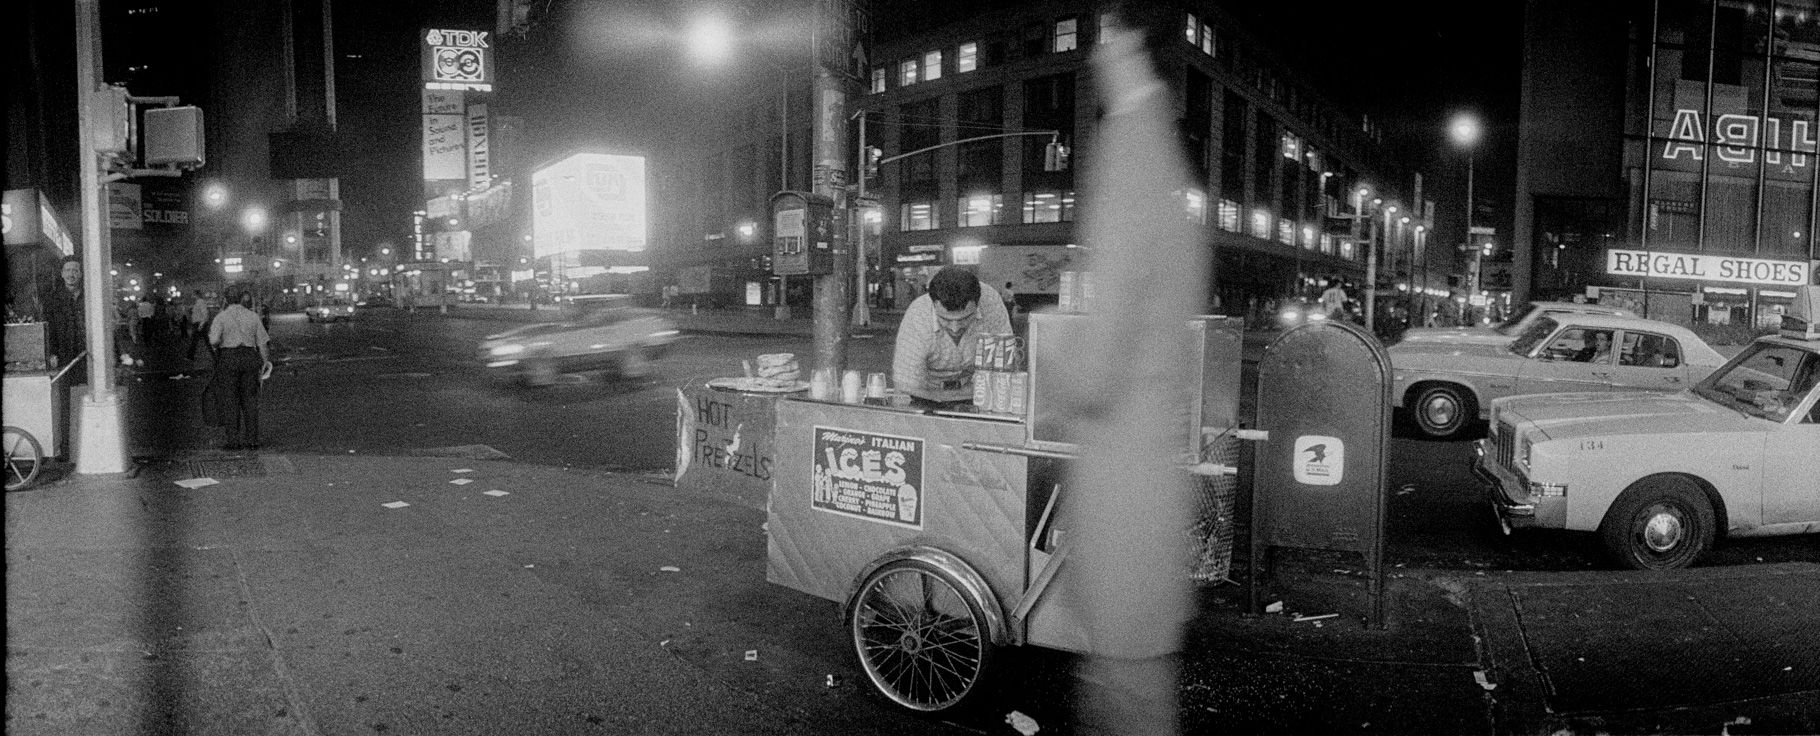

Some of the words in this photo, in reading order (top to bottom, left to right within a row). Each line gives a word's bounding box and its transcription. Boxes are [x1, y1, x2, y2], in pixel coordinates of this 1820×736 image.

[441, 29, 489, 48] TDK
[1614, 252, 1706, 277] REGAL
[1719, 260, 1802, 283] SHOES
[697, 396, 733, 430] HOT
[871, 437, 915, 452] ITALIAN
[825, 447, 906, 485] ICES
[839, 480, 859, 490] LEMON
[864, 485, 897, 497] CHOCOLATE
[843, 489, 865, 499] ORANGE
[836, 502, 862, 512] COCONUT
[867, 507, 896, 518] RAINBOW
[839, 495, 860, 505] CHERRY
[865, 500, 897, 511] PINEAPPLE
